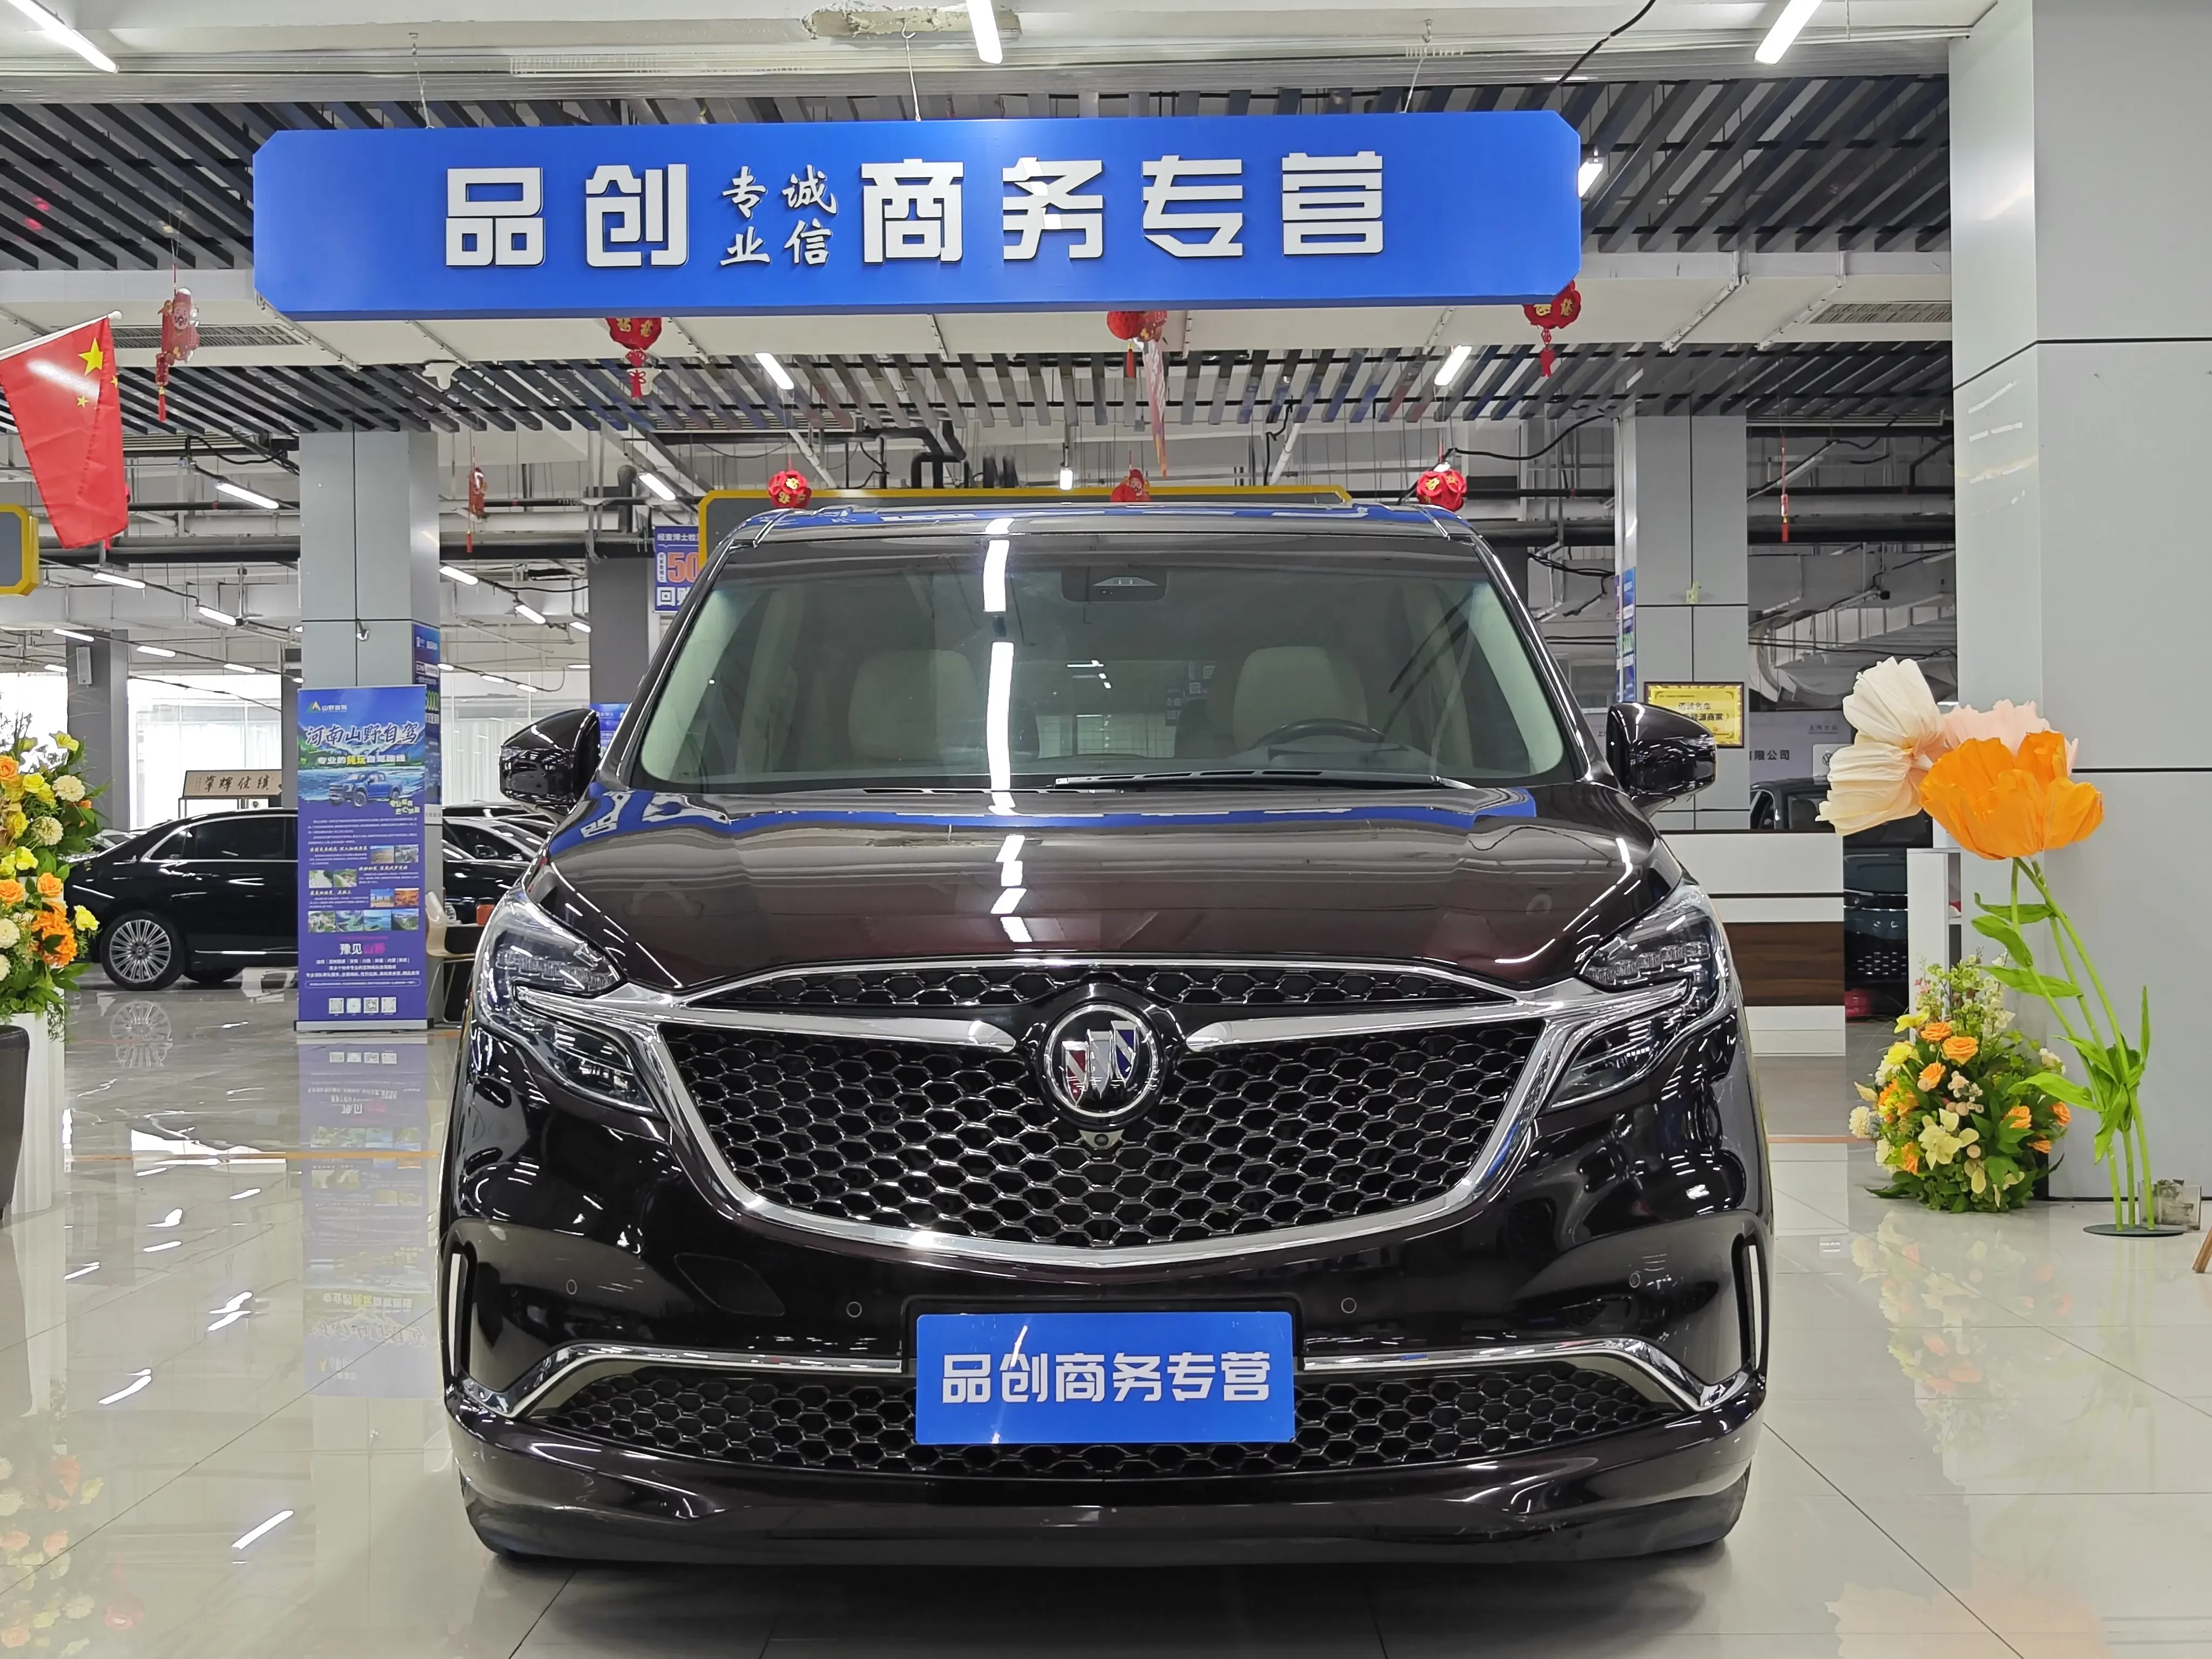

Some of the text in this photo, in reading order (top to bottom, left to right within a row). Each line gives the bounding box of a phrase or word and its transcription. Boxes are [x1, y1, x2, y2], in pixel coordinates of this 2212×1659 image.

[446, 163, 689, 268] 品创
[719, 166, 771, 267] 专业
[781, 164, 838, 266] 诚信
[861, 151, 1384, 264] 商务专营
[305, 720, 420, 747] 河南山野自驾
[942, 1352, 1271, 1404] 品创商务专营
